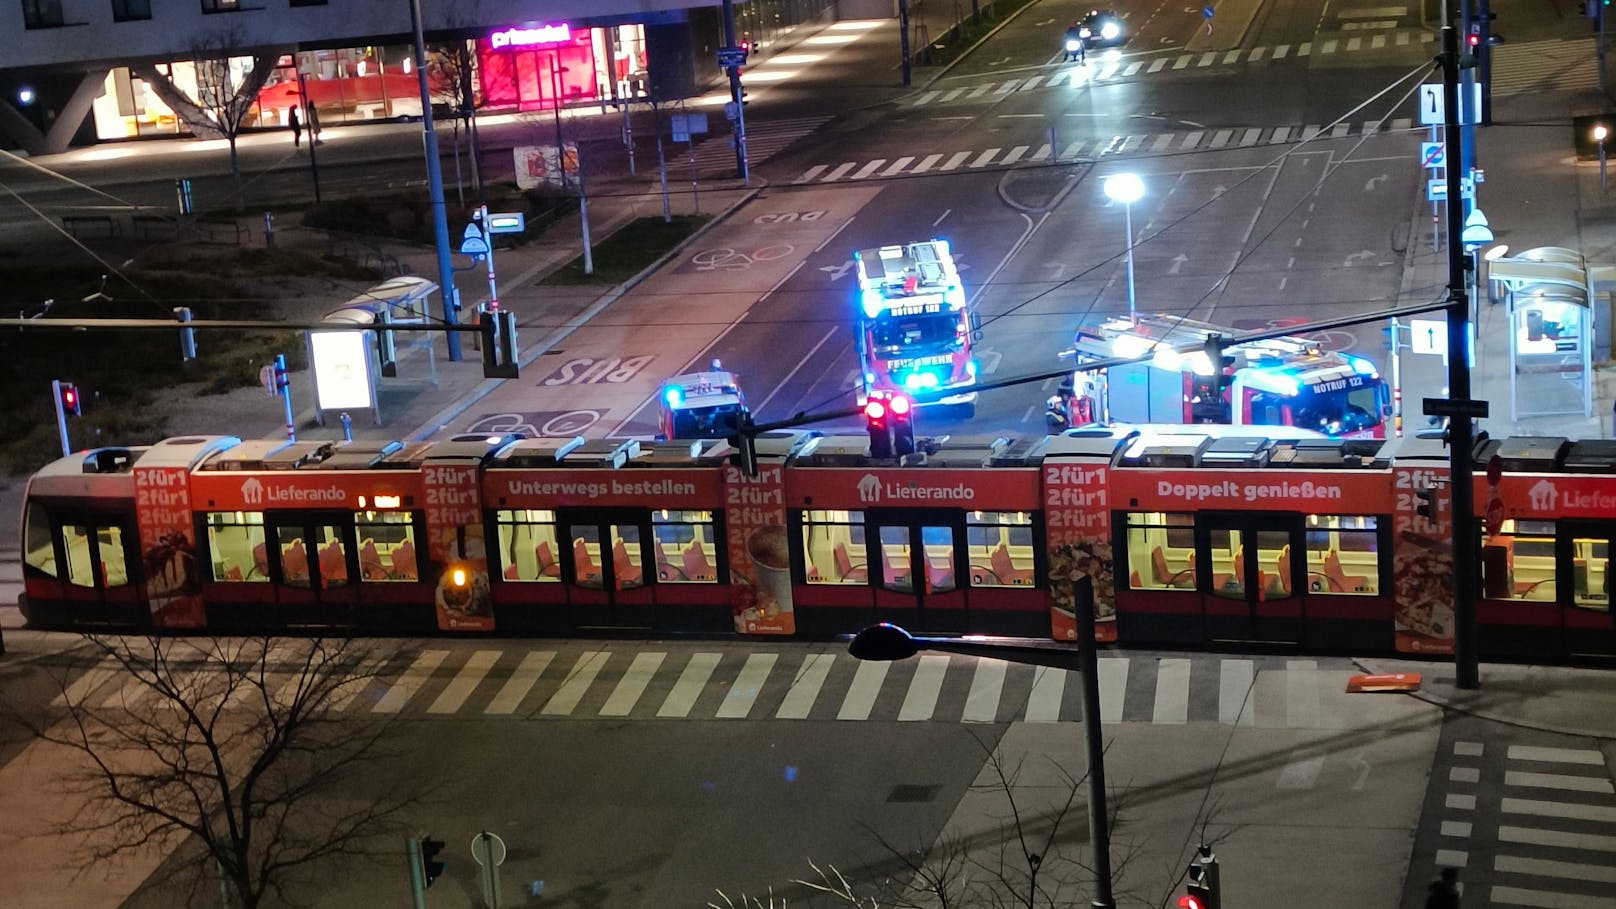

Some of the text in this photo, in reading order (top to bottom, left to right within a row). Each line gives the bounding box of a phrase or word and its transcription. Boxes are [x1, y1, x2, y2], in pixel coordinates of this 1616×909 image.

[544, 355, 655, 386] BUS
[1313, 376, 1363, 394] NOTRUF 122
[136, 469, 186, 486] 2für1
[425, 467, 476, 484] 2für1
[1047, 466, 1106, 485] 2für1
[1396, 470, 1450, 490] 2für
[138, 488, 188, 506] 2für1
[267, 485, 346, 501] Lieferando
[427, 488, 478, 505] 2für1
[508, 480, 696, 498] Unterwegs bestellen
[728, 486, 783, 504] 2für1
[1047, 487, 1107, 506] 2für1
[1158, 481, 1341, 501] Doppelt genießen
[140, 507, 191, 525] 2für1
[428, 507, 480, 524] 2für1
[729, 507, 785, 525] 2für1
[1048, 509, 1107, 528] 2für1
